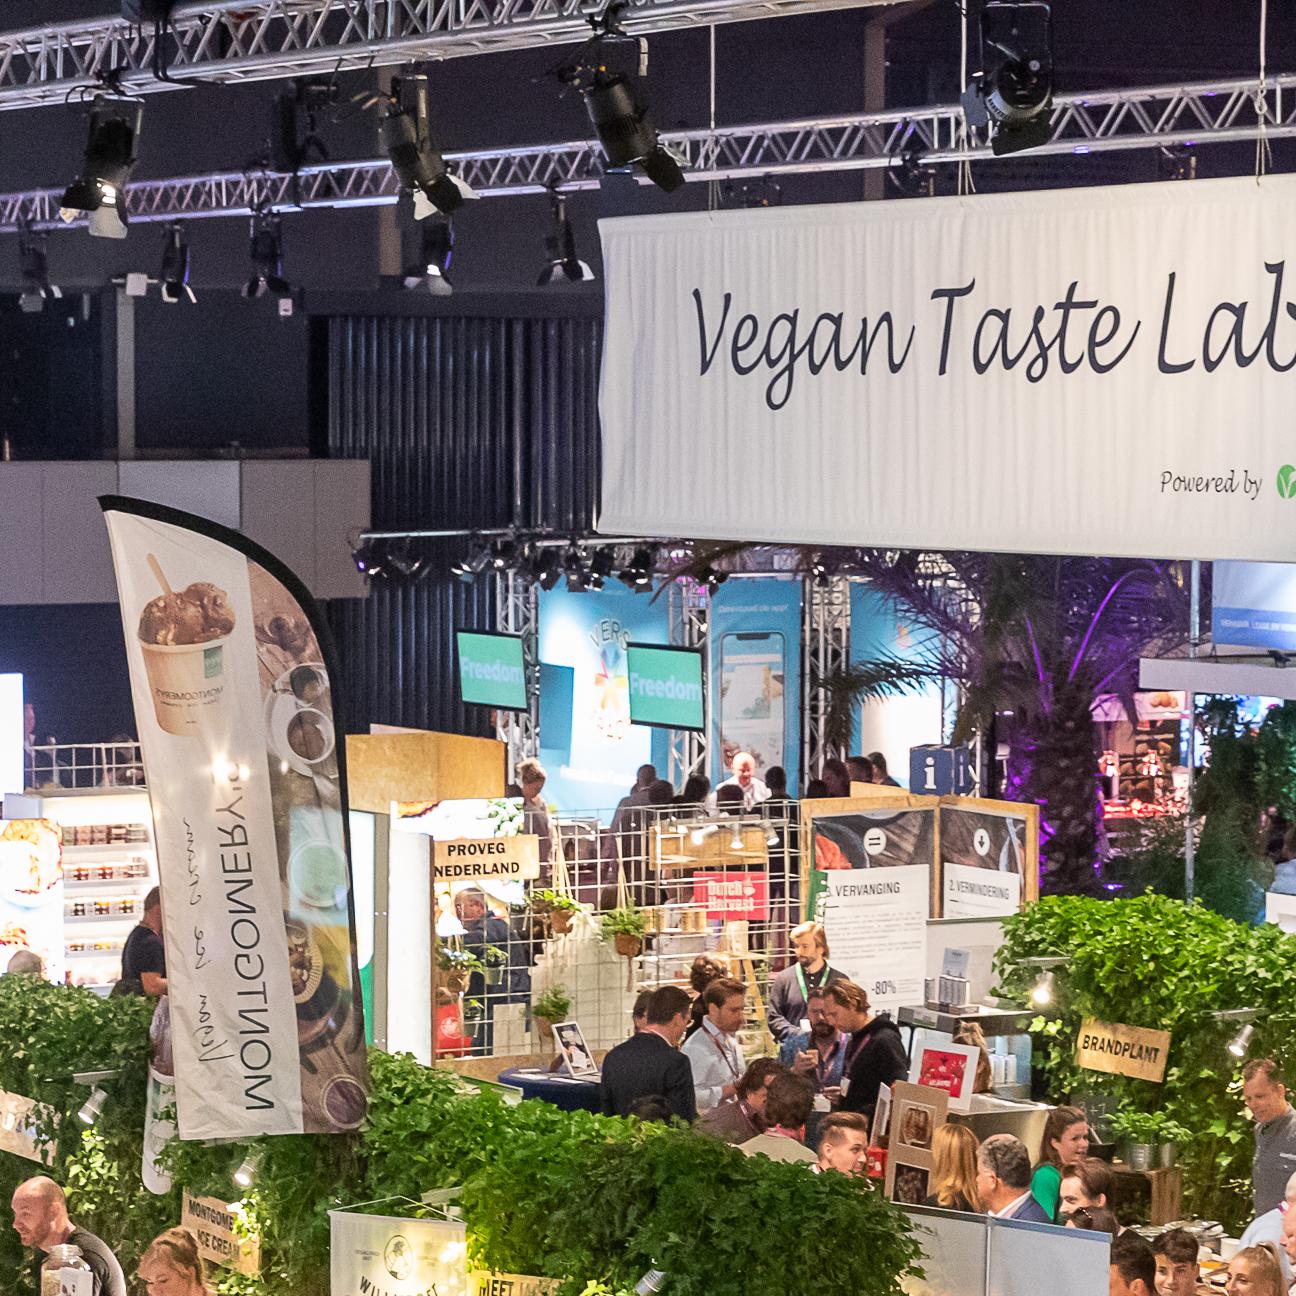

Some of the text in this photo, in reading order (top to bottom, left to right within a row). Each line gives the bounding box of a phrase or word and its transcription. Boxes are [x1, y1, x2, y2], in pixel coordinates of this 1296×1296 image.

[692, 287, 915, 411] Vegan
[930, 277, 1142, 384] Taste
[1160, 469, 1263, 501] Powered by
[461, 656, 522, 685] Freedom
[630, 673, 701, 701] Freedom
[447, 842, 505, 857] PROVEG
[434, 861, 520, 878] NEDERLAND
[835, 881, 901, 898] VERVANGING
[956, 880, 1010, 900] VERMINDERING
[1082, 1034, 1161, 1064] BRANDPLANT
